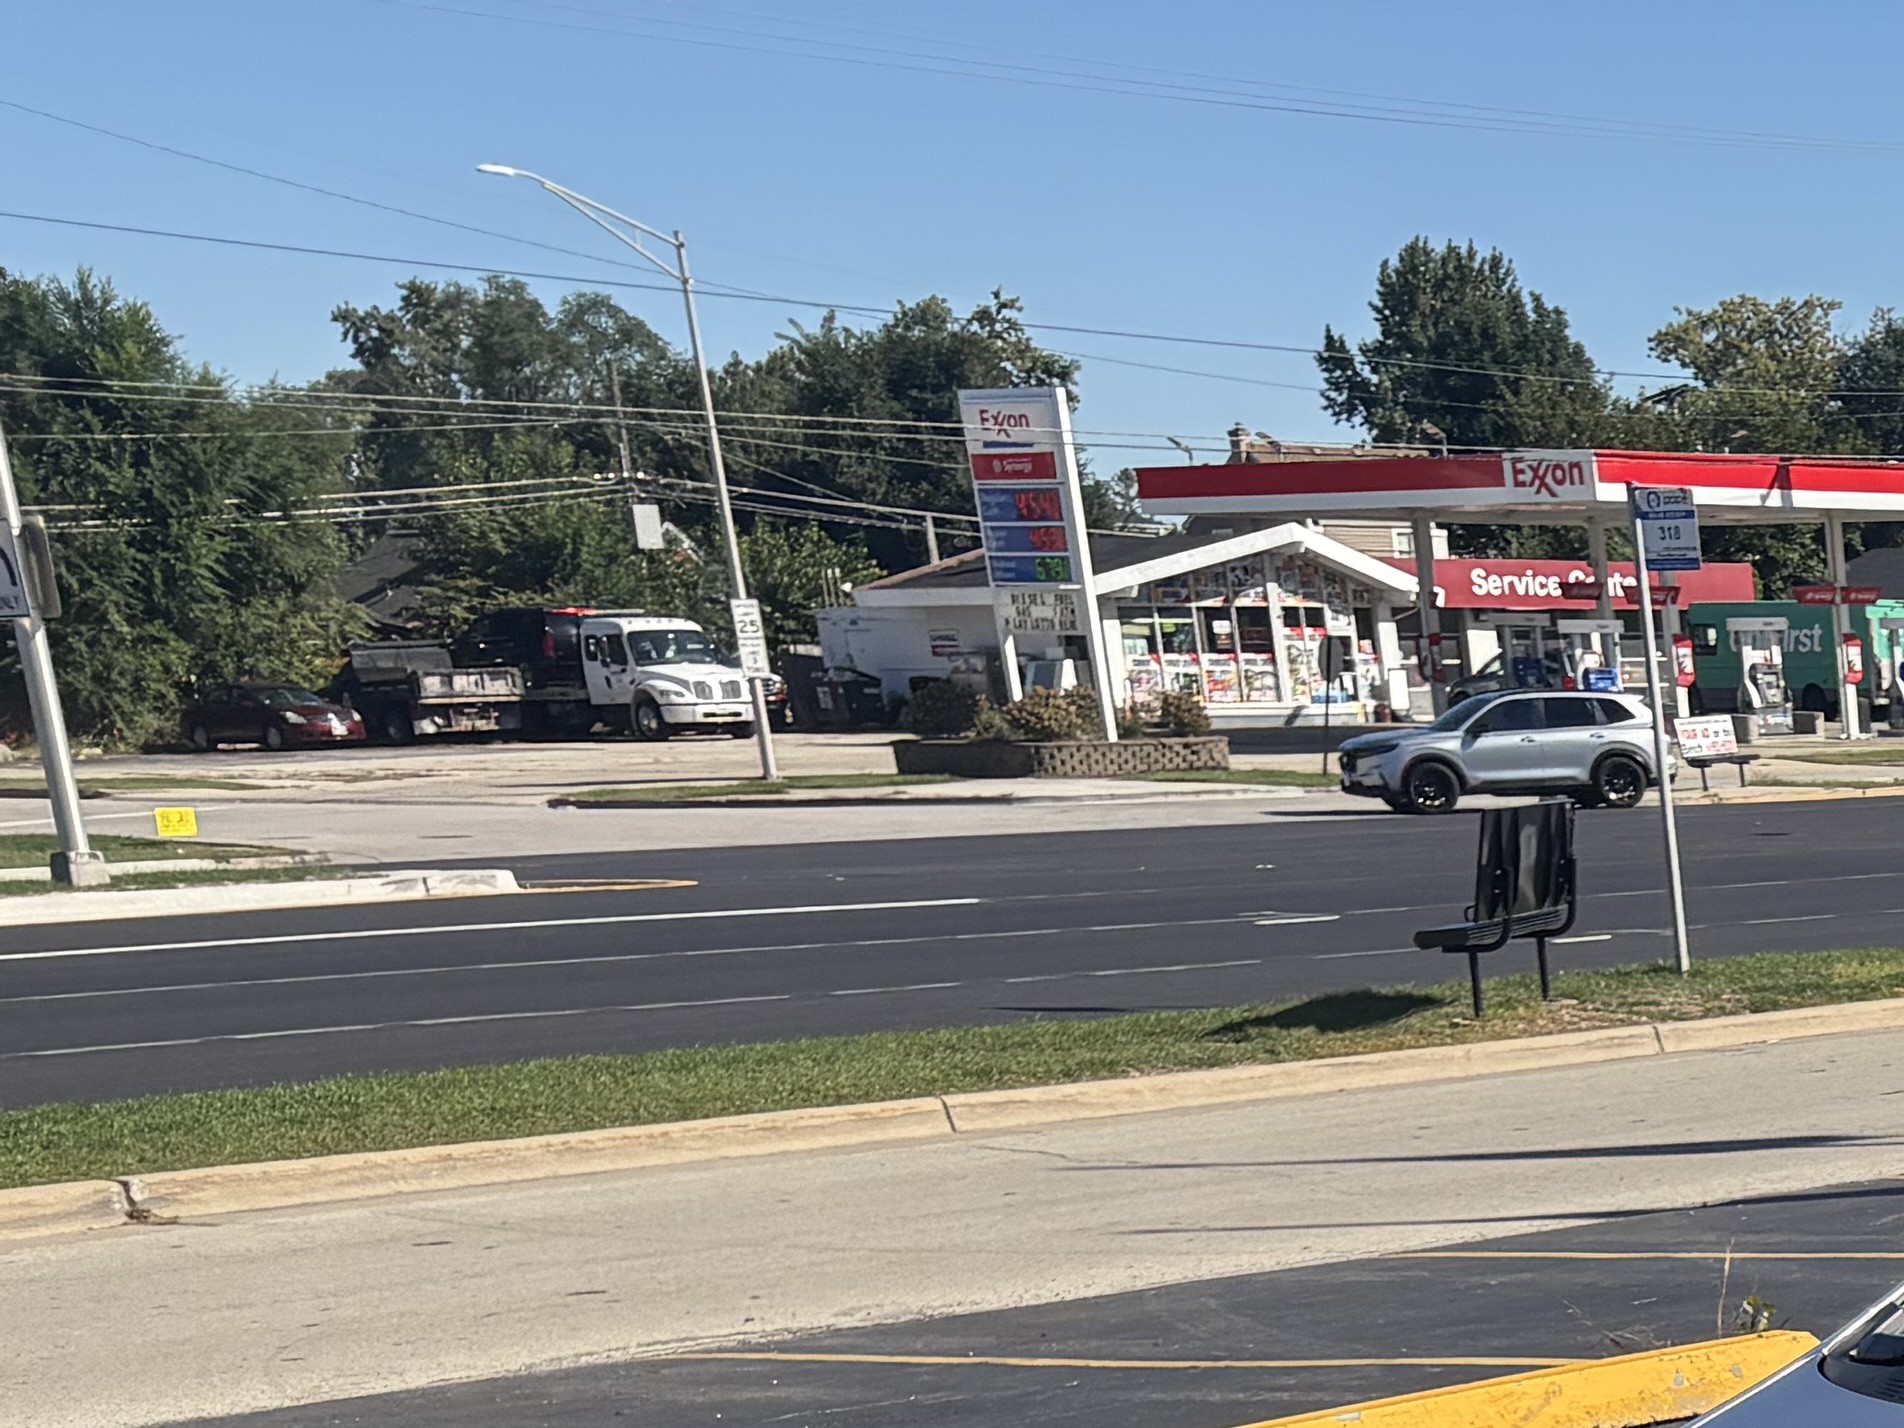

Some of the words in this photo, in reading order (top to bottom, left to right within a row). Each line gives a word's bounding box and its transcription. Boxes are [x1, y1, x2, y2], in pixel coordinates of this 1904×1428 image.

[979, 409, 1030, 438] Exxon
[1512, 457, 1584, 498] Exxon
[1471, 568, 1563, 597] Service
[738, 620, 760, 633] 25
